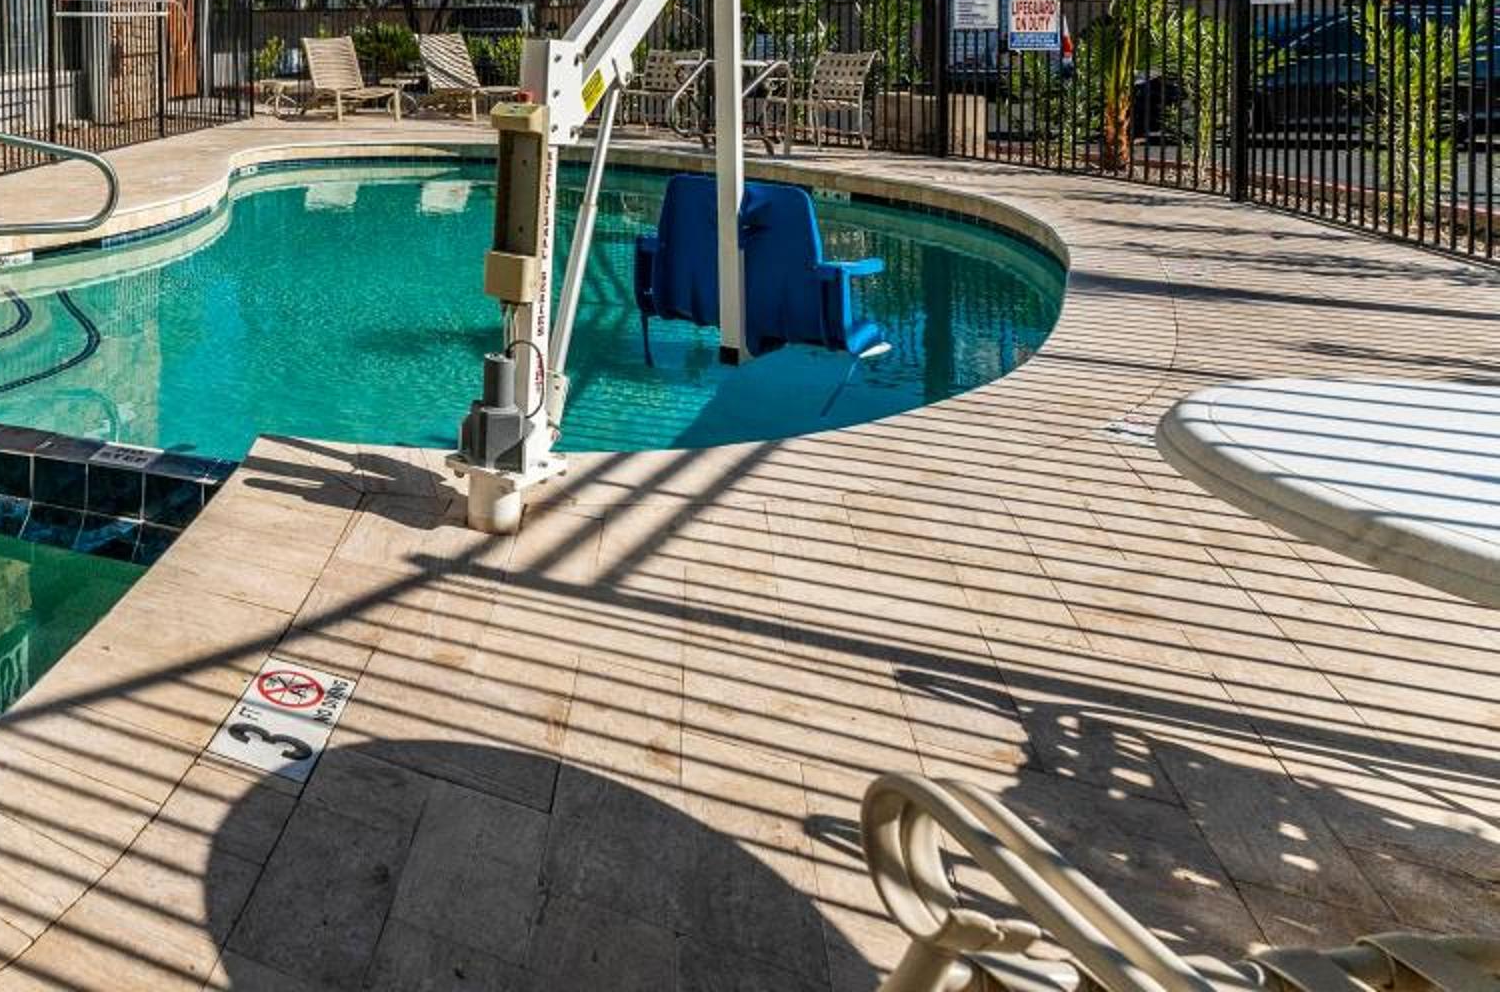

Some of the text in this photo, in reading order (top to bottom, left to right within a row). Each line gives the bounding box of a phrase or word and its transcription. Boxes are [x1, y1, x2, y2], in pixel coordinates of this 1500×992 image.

[1011, 0, 1056, 15] LIFEGUARD
[1015, 16, 1051, 31] ON DUTY
[228, 722, 313, 761] 3
